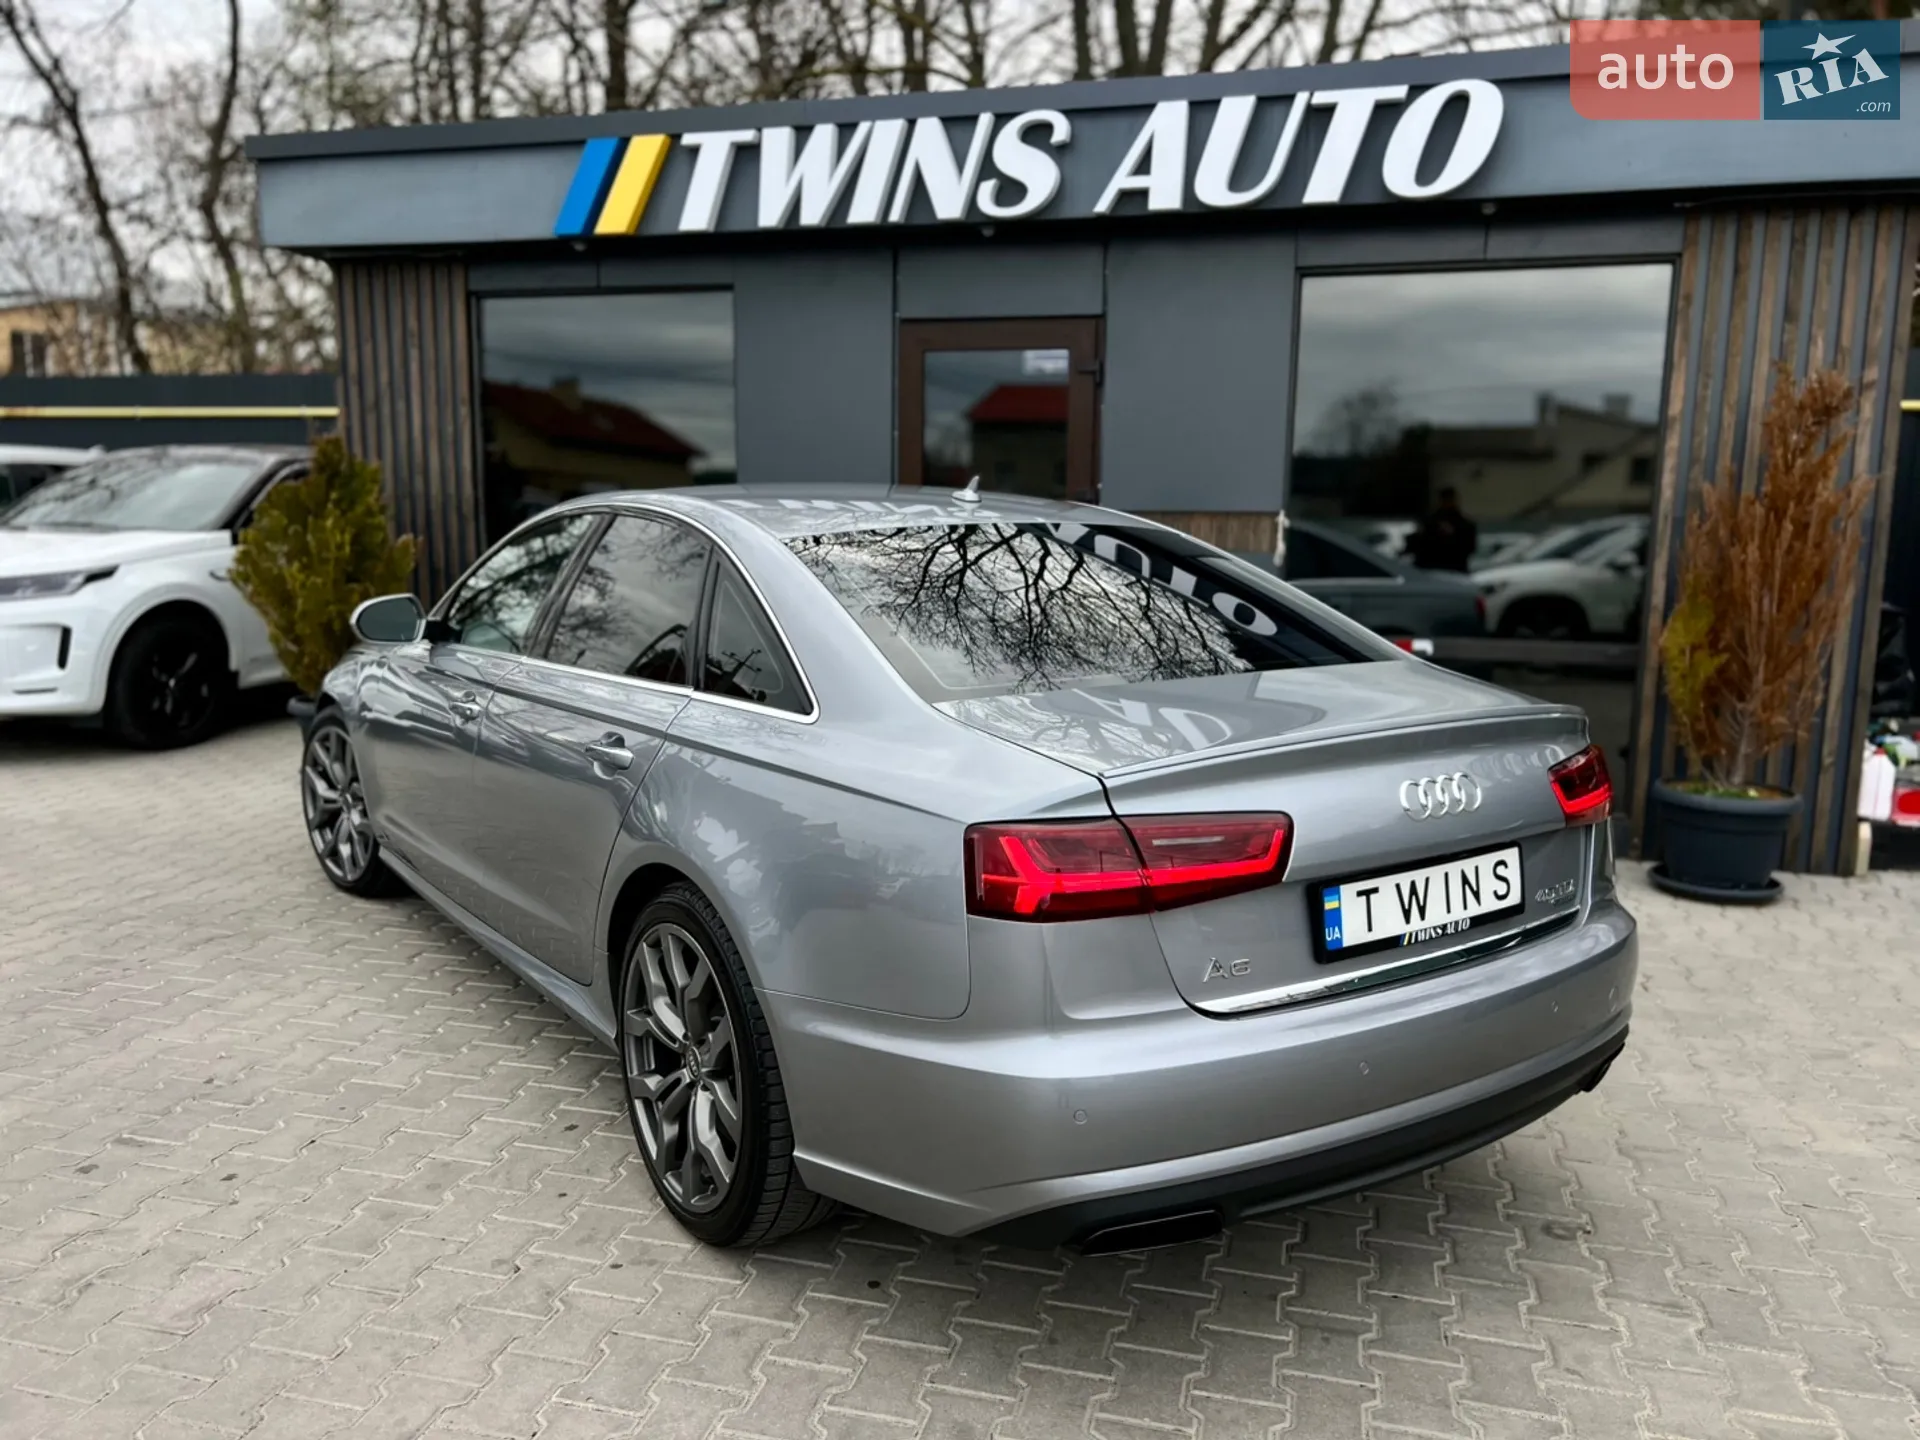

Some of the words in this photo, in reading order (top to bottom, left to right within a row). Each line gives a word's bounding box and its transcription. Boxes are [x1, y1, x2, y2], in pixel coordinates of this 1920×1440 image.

[677, 108, 1072, 233] TWINS
[1093, 78, 1506, 215] AUTO
[1355, 858, 1512, 934] TWINS
[1325, 926, 1342, 941] UA
[1410, 924, 1443, 944] TWINS
[1444, 917, 1471, 936] AUTO
[1202, 957, 1251, 983] A6
